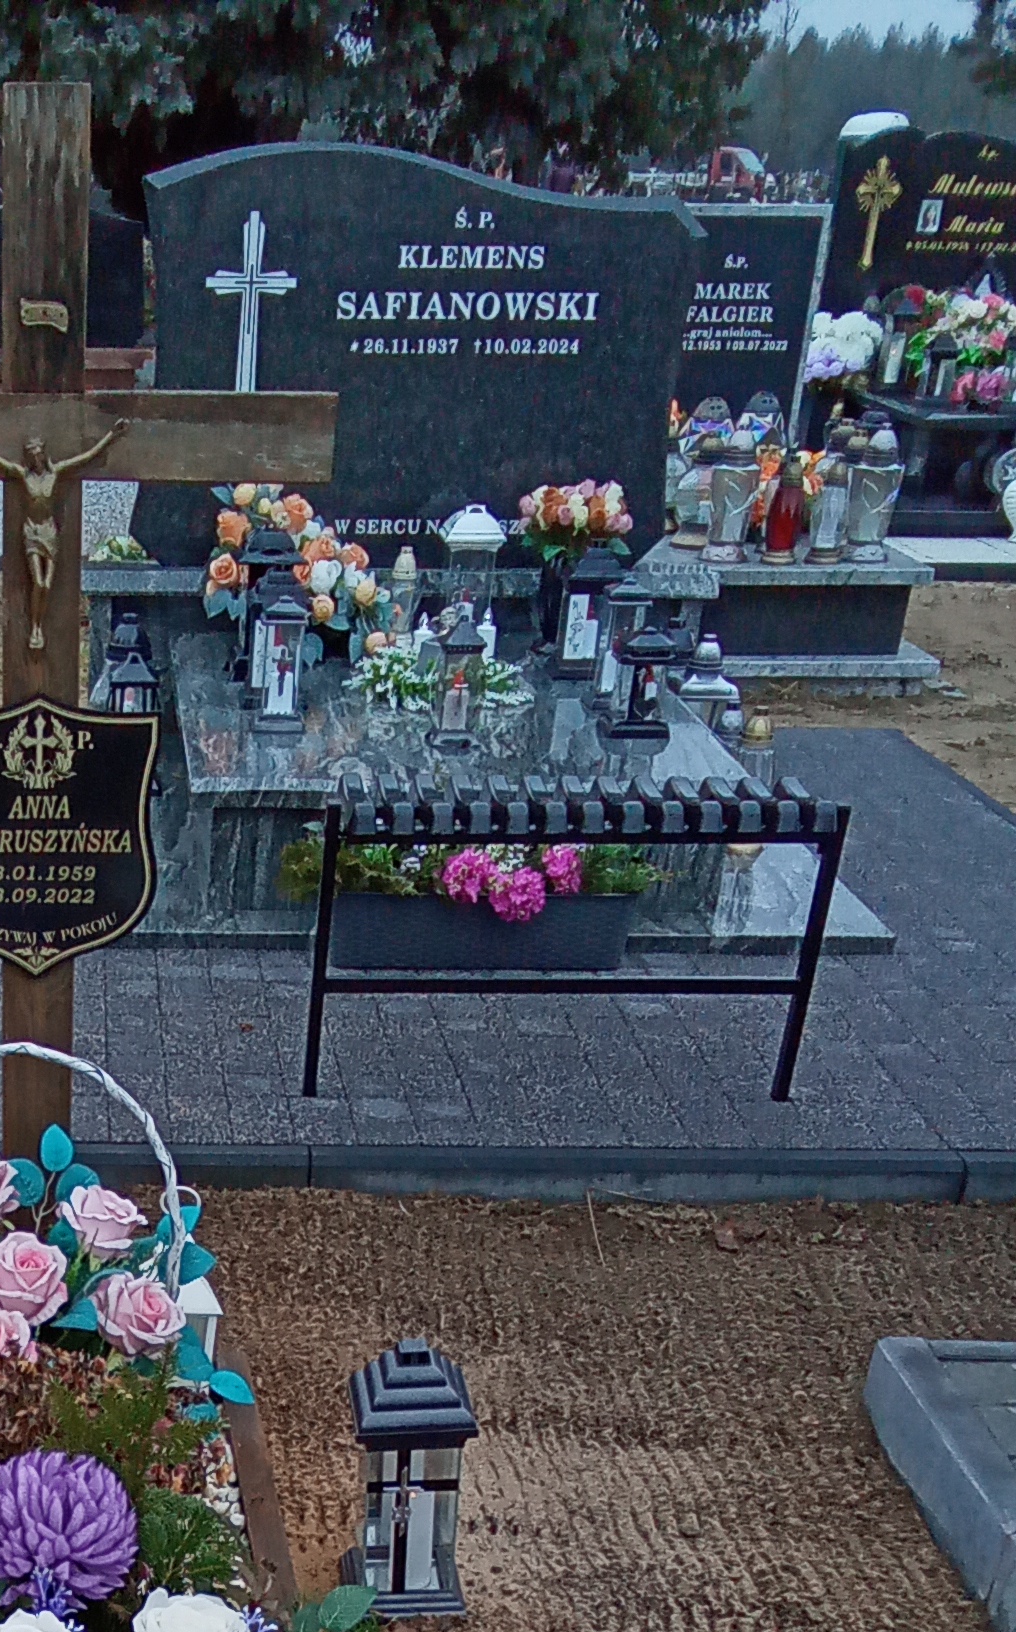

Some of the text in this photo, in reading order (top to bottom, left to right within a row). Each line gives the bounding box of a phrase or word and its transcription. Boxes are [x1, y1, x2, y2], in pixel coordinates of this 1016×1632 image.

[478, 210, 496, 229] P.
[944, 214, 1005, 234] Maria
[397, 244, 546, 269] KLEMENS
[693, 282, 772, 300] MAREK
[336, 290, 600, 321] SAFIANOWSKI
[686, 305, 774, 323] FALGIER
[362, 337, 580, 355] 26.11.1937 10.02.2024
[334, 518, 351, 535] W
[354, 518, 421, 535] SERCU
[77, 730, 95, 750] P.
[8, 795, 71, 820] ANNA
[42, 931, 56, 944] W
[60, 910, 119, 942] POKOJU
